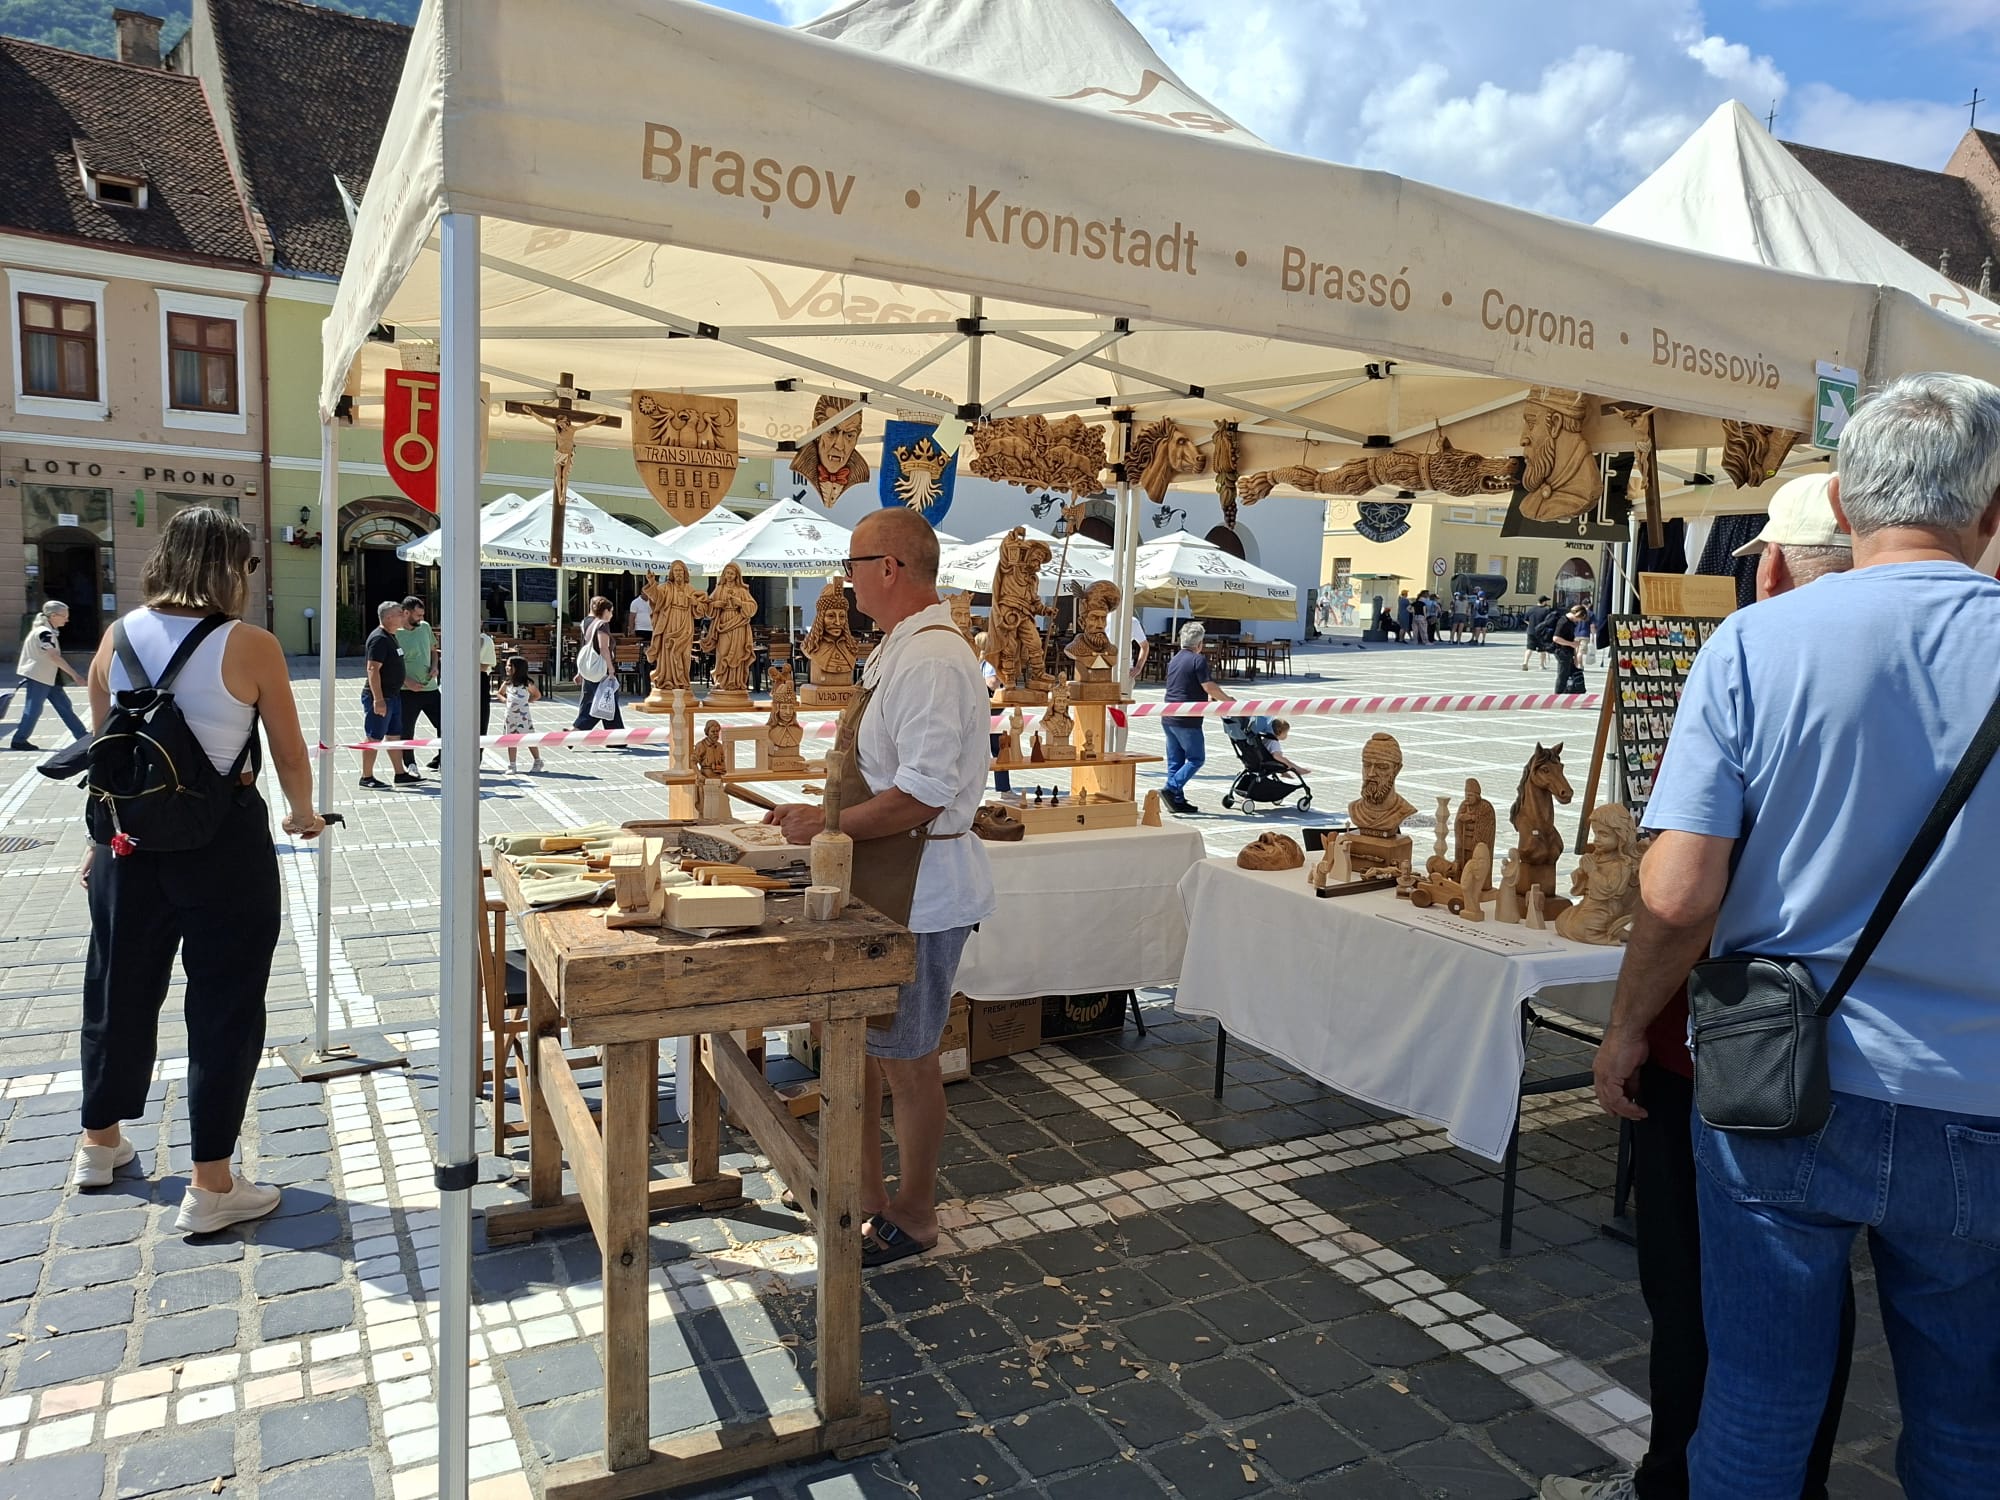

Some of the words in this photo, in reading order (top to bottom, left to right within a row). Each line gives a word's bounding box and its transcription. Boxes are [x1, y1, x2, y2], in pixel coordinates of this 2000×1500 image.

[642, 121, 856, 220] Brașov
[965, 184, 1200, 277] Kronstadt
[1281, 245, 1411, 312] Brassó
[1481, 288, 1595, 351] Corona
[1651, 327, 1782, 390] Brassovia
[645, 446, 735, 467] TRANSILVANIA
[24, 458, 102, 477] LOTO
[144, 467, 236, 487] PRONO
[1176, 577, 1199, 588] Kozel
[1223, 580, 1246, 591] Kozel
[1267, 587, 1290, 598] Kozel
[982, 1004, 1006, 1016] FRESH
